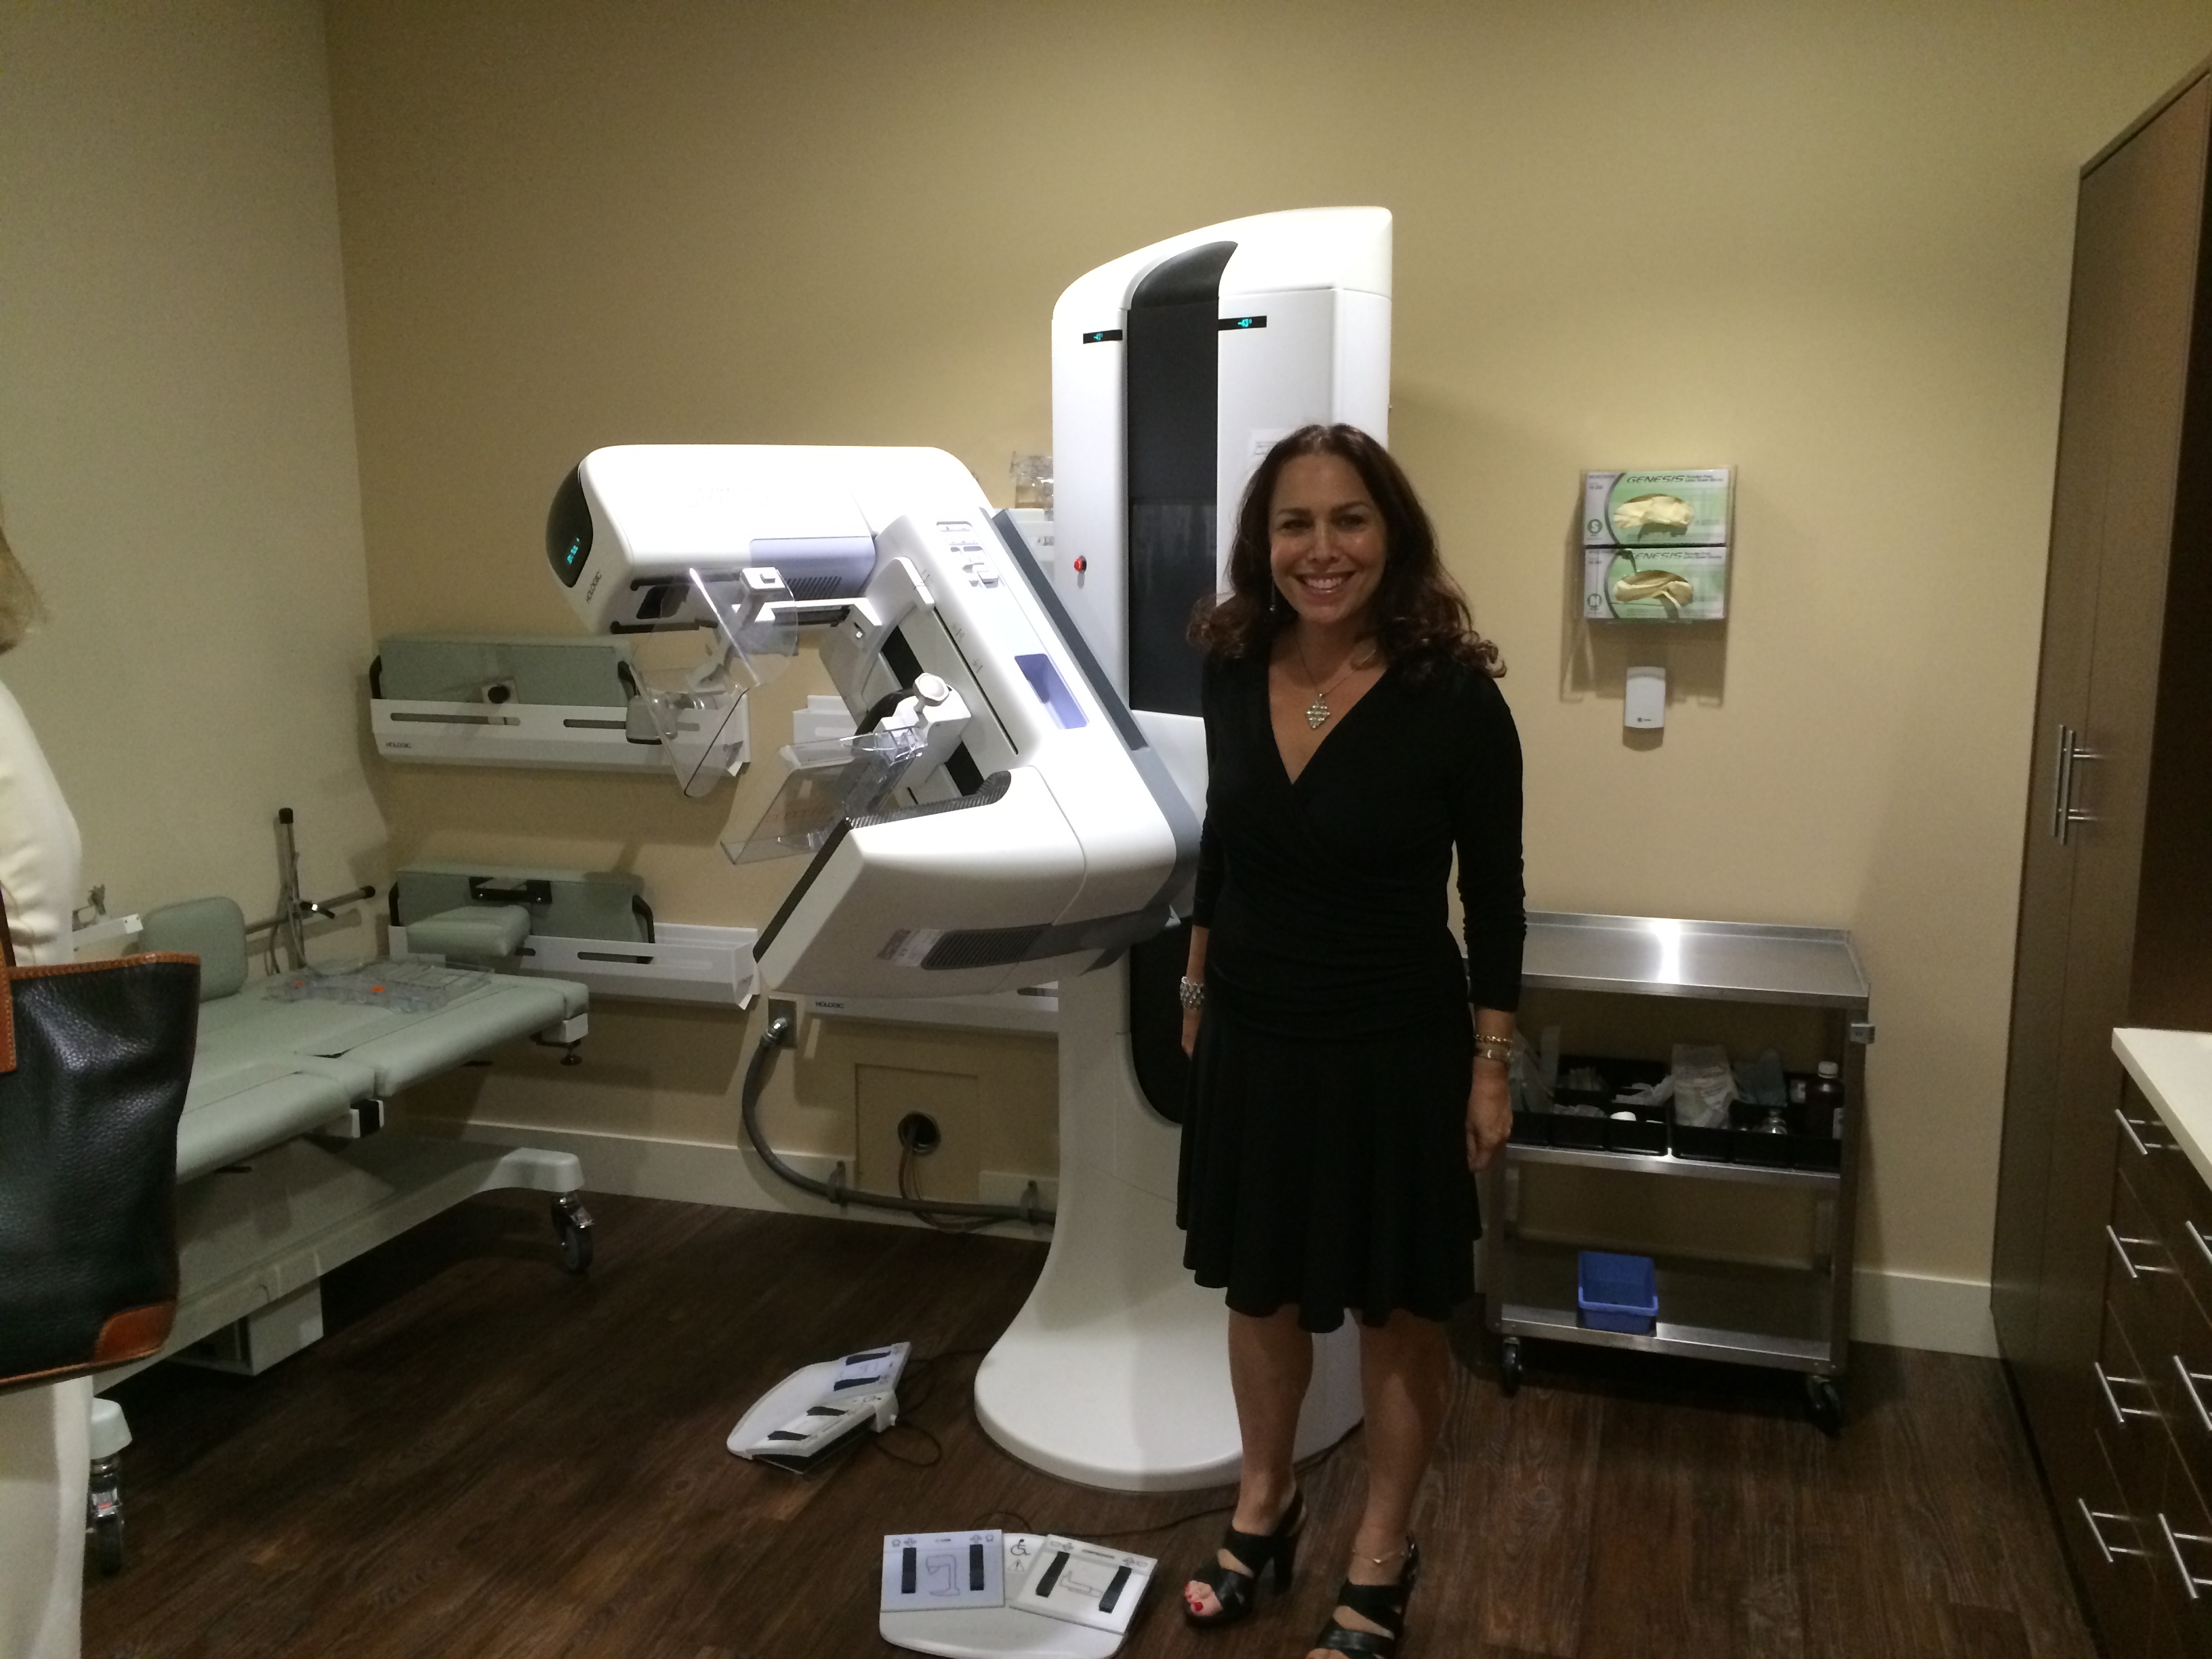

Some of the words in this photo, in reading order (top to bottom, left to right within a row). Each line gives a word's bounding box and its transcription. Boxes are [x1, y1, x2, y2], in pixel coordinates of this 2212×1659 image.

[1626, 475, 1685, 484] GENESIS
[586, 571, 602, 605] HOLOGIC
[815, 1001, 845, 1009] HOLOGIC
